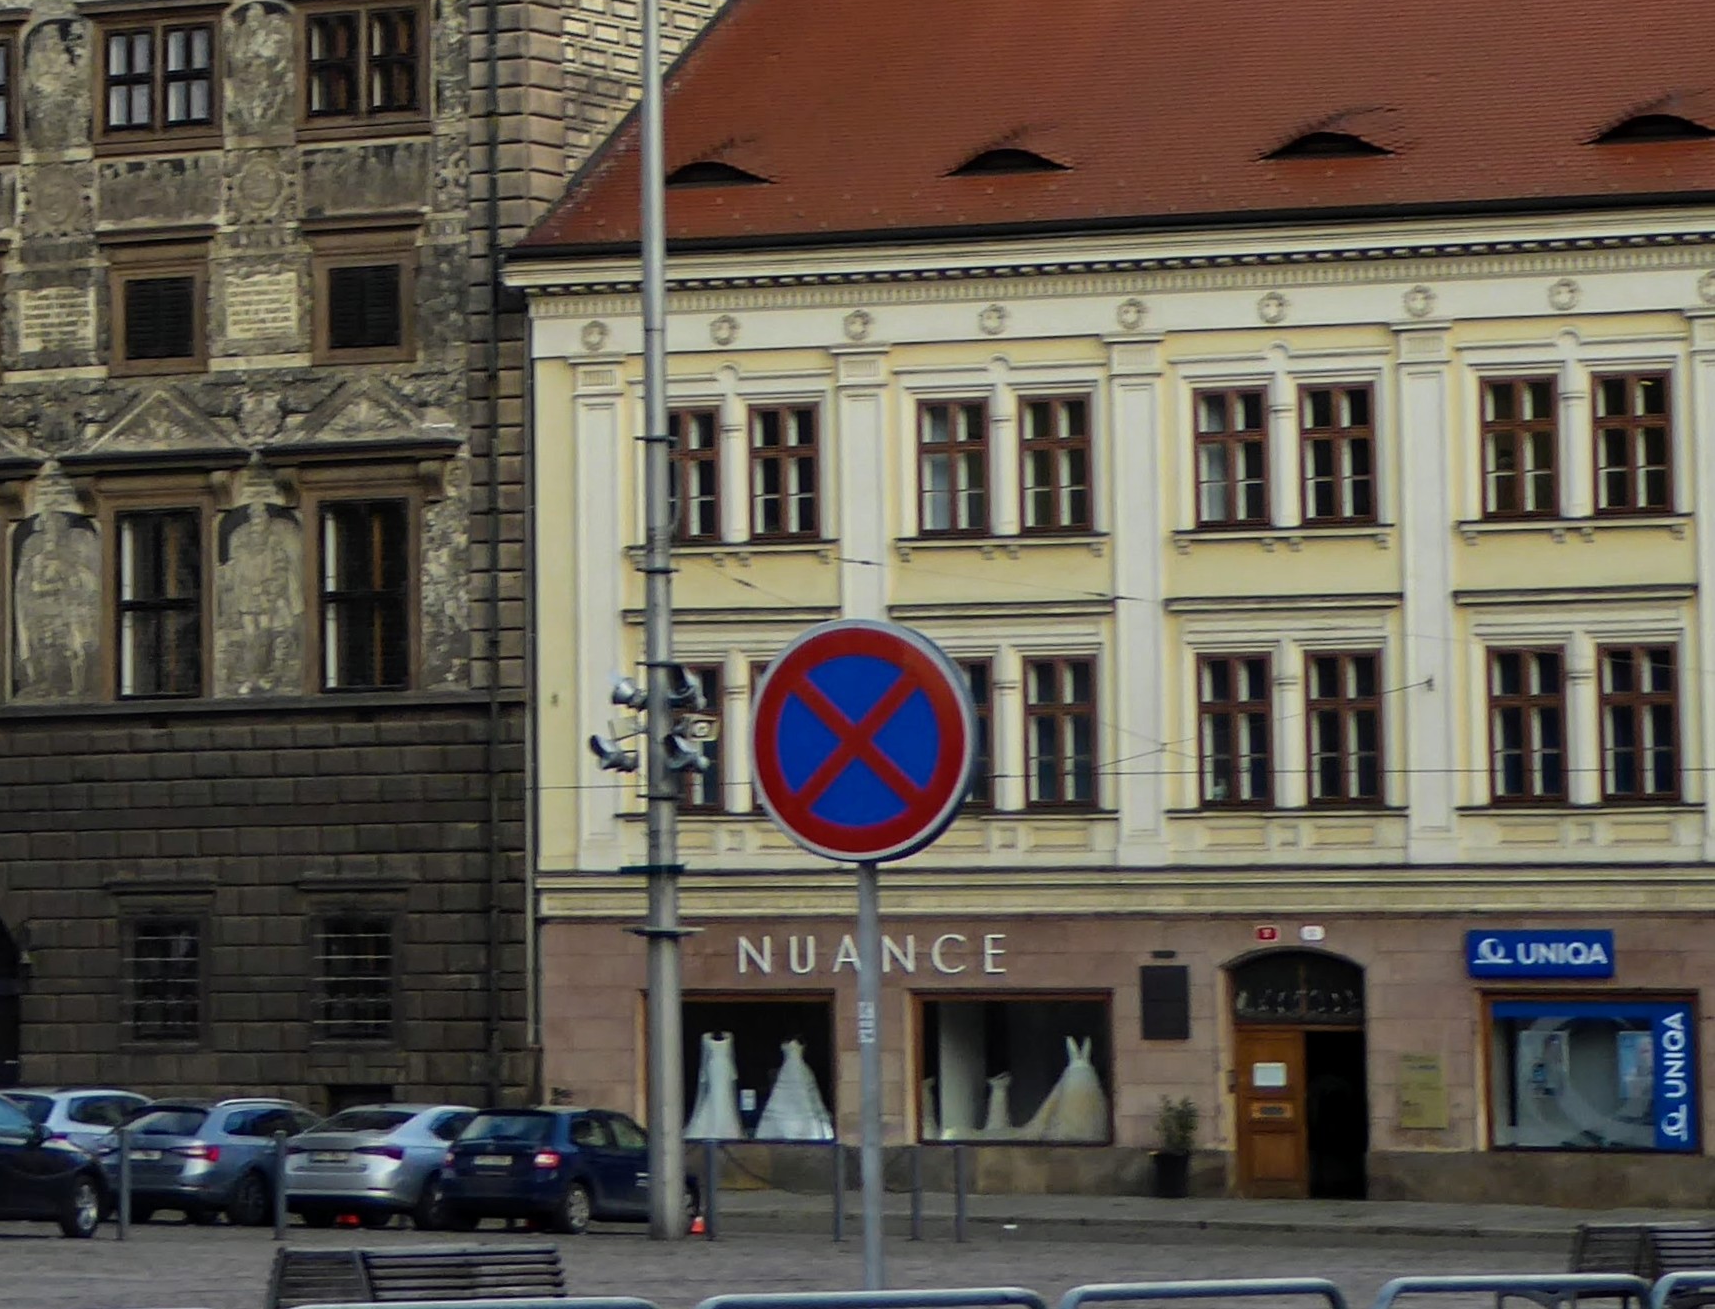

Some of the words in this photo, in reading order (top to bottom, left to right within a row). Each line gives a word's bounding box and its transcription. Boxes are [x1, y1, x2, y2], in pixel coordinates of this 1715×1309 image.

[738, 934, 1007, 973] NUANCE
[1516, 942, 1608, 964] UNIQA
[1661, 1012, 1687, 1098] UNIQA
